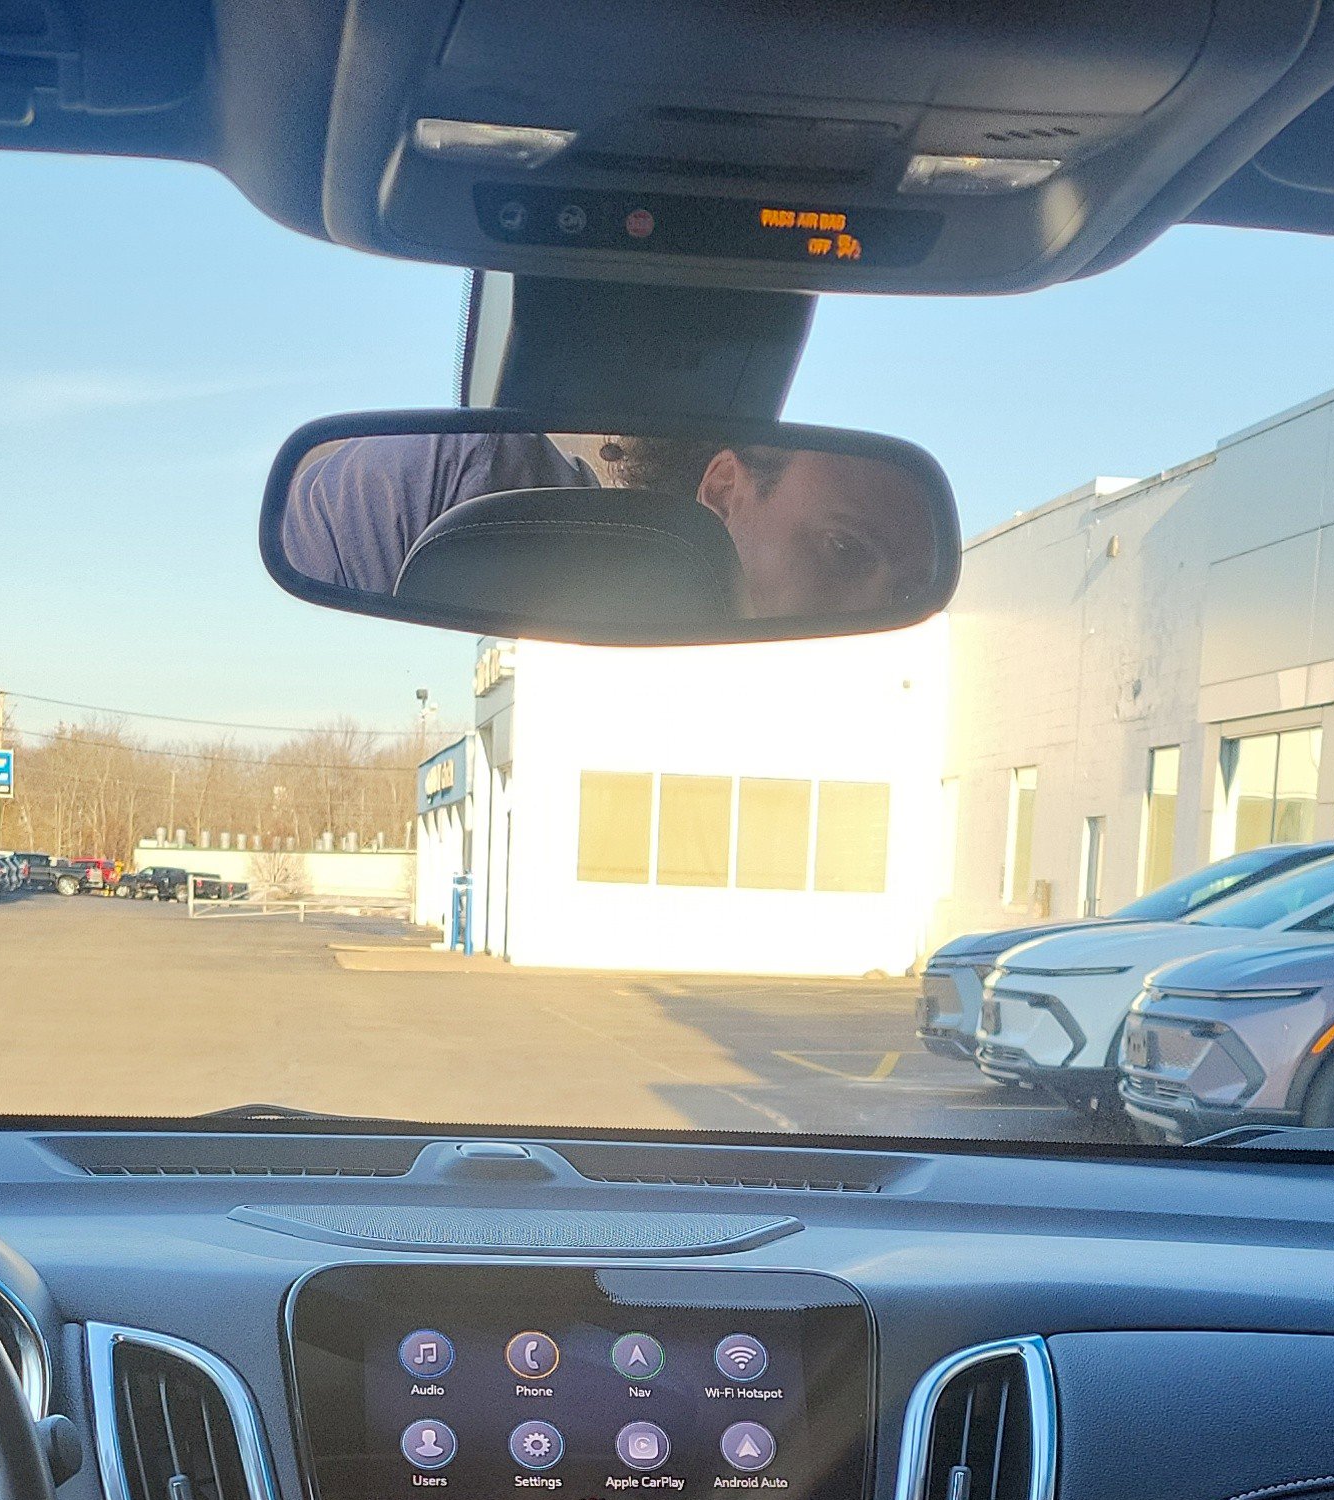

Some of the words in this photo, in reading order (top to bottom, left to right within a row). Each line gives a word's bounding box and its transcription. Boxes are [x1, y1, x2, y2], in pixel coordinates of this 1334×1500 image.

[410, 1383, 445, 1397] Audio
[515, 1384, 554, 1399] Phone
[628, 1386, 652, 1399] Nav
[704, 1386, 734, 1400] Wi-Fi
[736, 1386, 784, 1402] Hotspot
[411, 1474, 448, 1488] Users
[513, 1474, 563, 1490] Settings
[605, 1475, 639, 1491] Apple
[640, 1475, 685, 1491] CarPlay
[713, 1475, 758, 1489] Android
[760, 1476, 789, 1489] Auto
